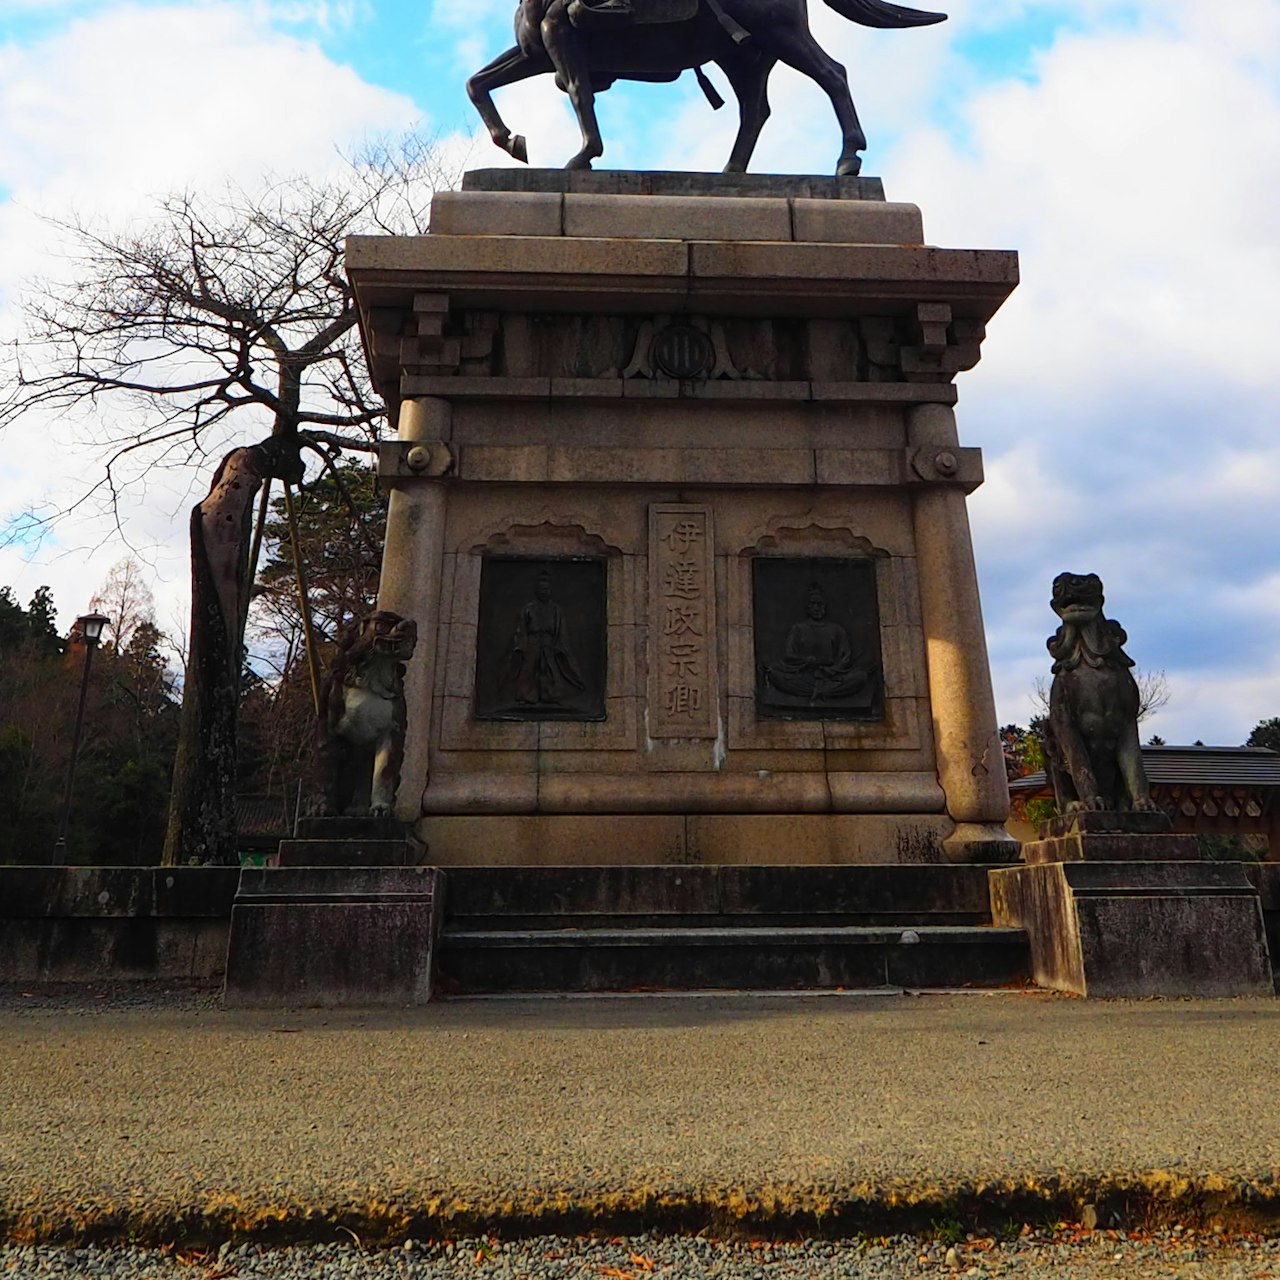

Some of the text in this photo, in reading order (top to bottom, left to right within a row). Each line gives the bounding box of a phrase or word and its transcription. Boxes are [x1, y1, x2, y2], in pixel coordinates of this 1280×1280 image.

[660, 521, 704, 719] 伊達政宗卿
